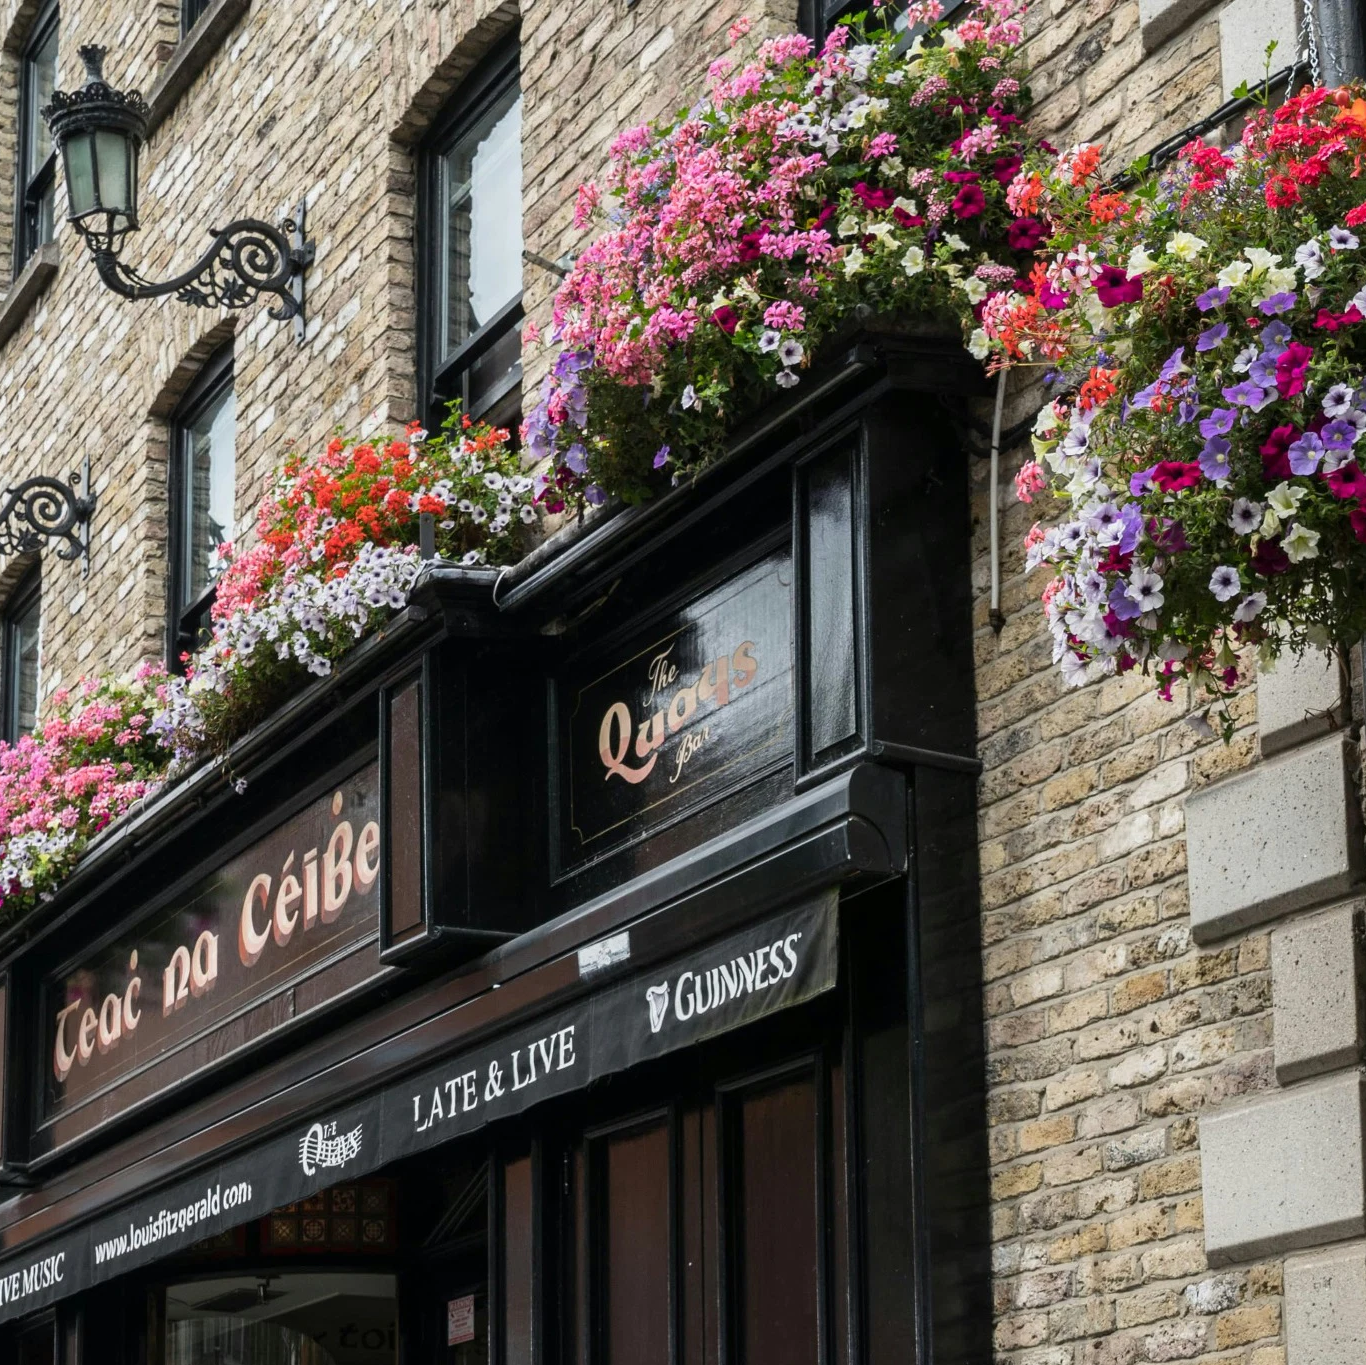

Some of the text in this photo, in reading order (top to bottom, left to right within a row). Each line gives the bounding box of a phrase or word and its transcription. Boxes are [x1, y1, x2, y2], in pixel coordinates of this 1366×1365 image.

[598, 640, 758, 784] Quays
[643, 643, 680, 707] The
[670, 725, 710, 783] Bar
[163, 930, 219, 1014] na
[674, 934, 800, 1022] GUINNESS
[412, 1025, 576, 1132] LATE & LIVE
[95, 1181, 252, 1265] www.louisfitzgeraldcom
[21, 1253, 65, 1302] MUSIC
